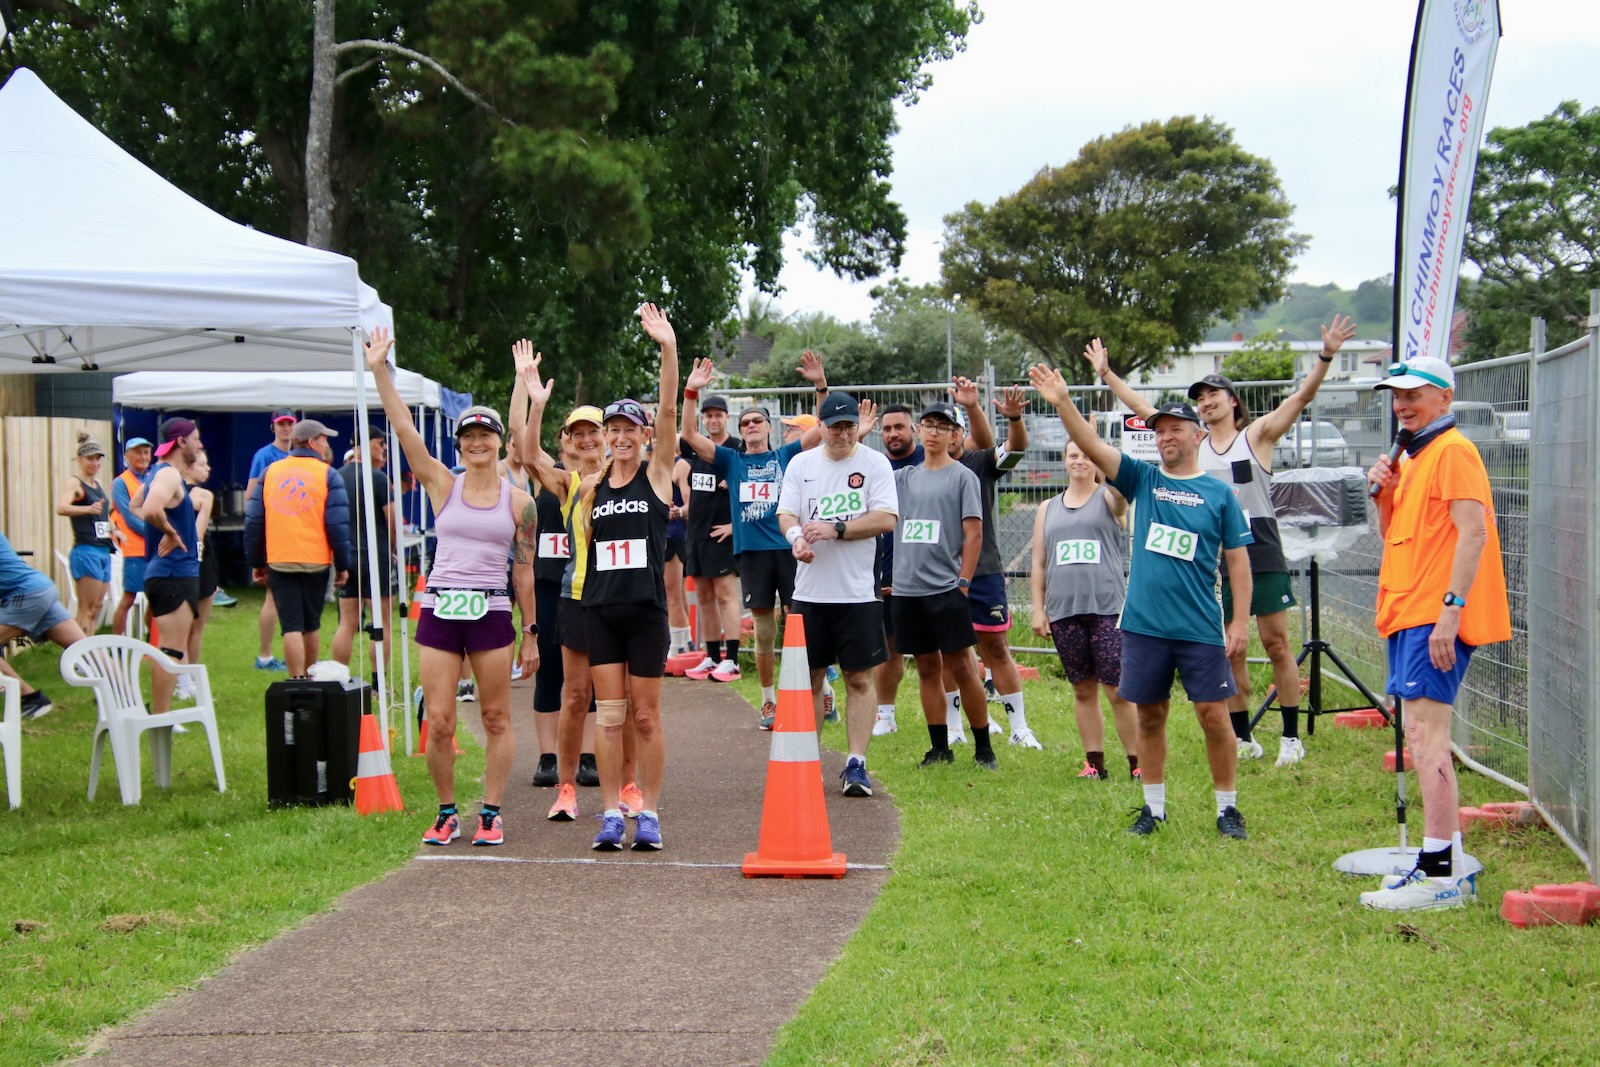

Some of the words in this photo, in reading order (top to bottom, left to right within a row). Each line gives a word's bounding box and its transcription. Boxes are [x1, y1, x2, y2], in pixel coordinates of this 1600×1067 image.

[1412, 164, 1444, 326] CHINMOY
[1436, 47, 1465, 165] RACES
[1131, 433, 1155, 441] KEEP
[692, 475, 714, 488] 644
[748, 483, 770, 500] 14
[592, 499, 649, 520] adidas
[820, 491, 862, 516] 228
[97, 523, 111, 535] 64
[904, 521, 934, 540] 221
[1060, 541, 1096, 561] 218
[1150, 526, 1193, 556] 219
[606, 541, 631, 566] 11
[437, 593, 485, 617] 220
[1435, 889, 1460, 900] HOKA
